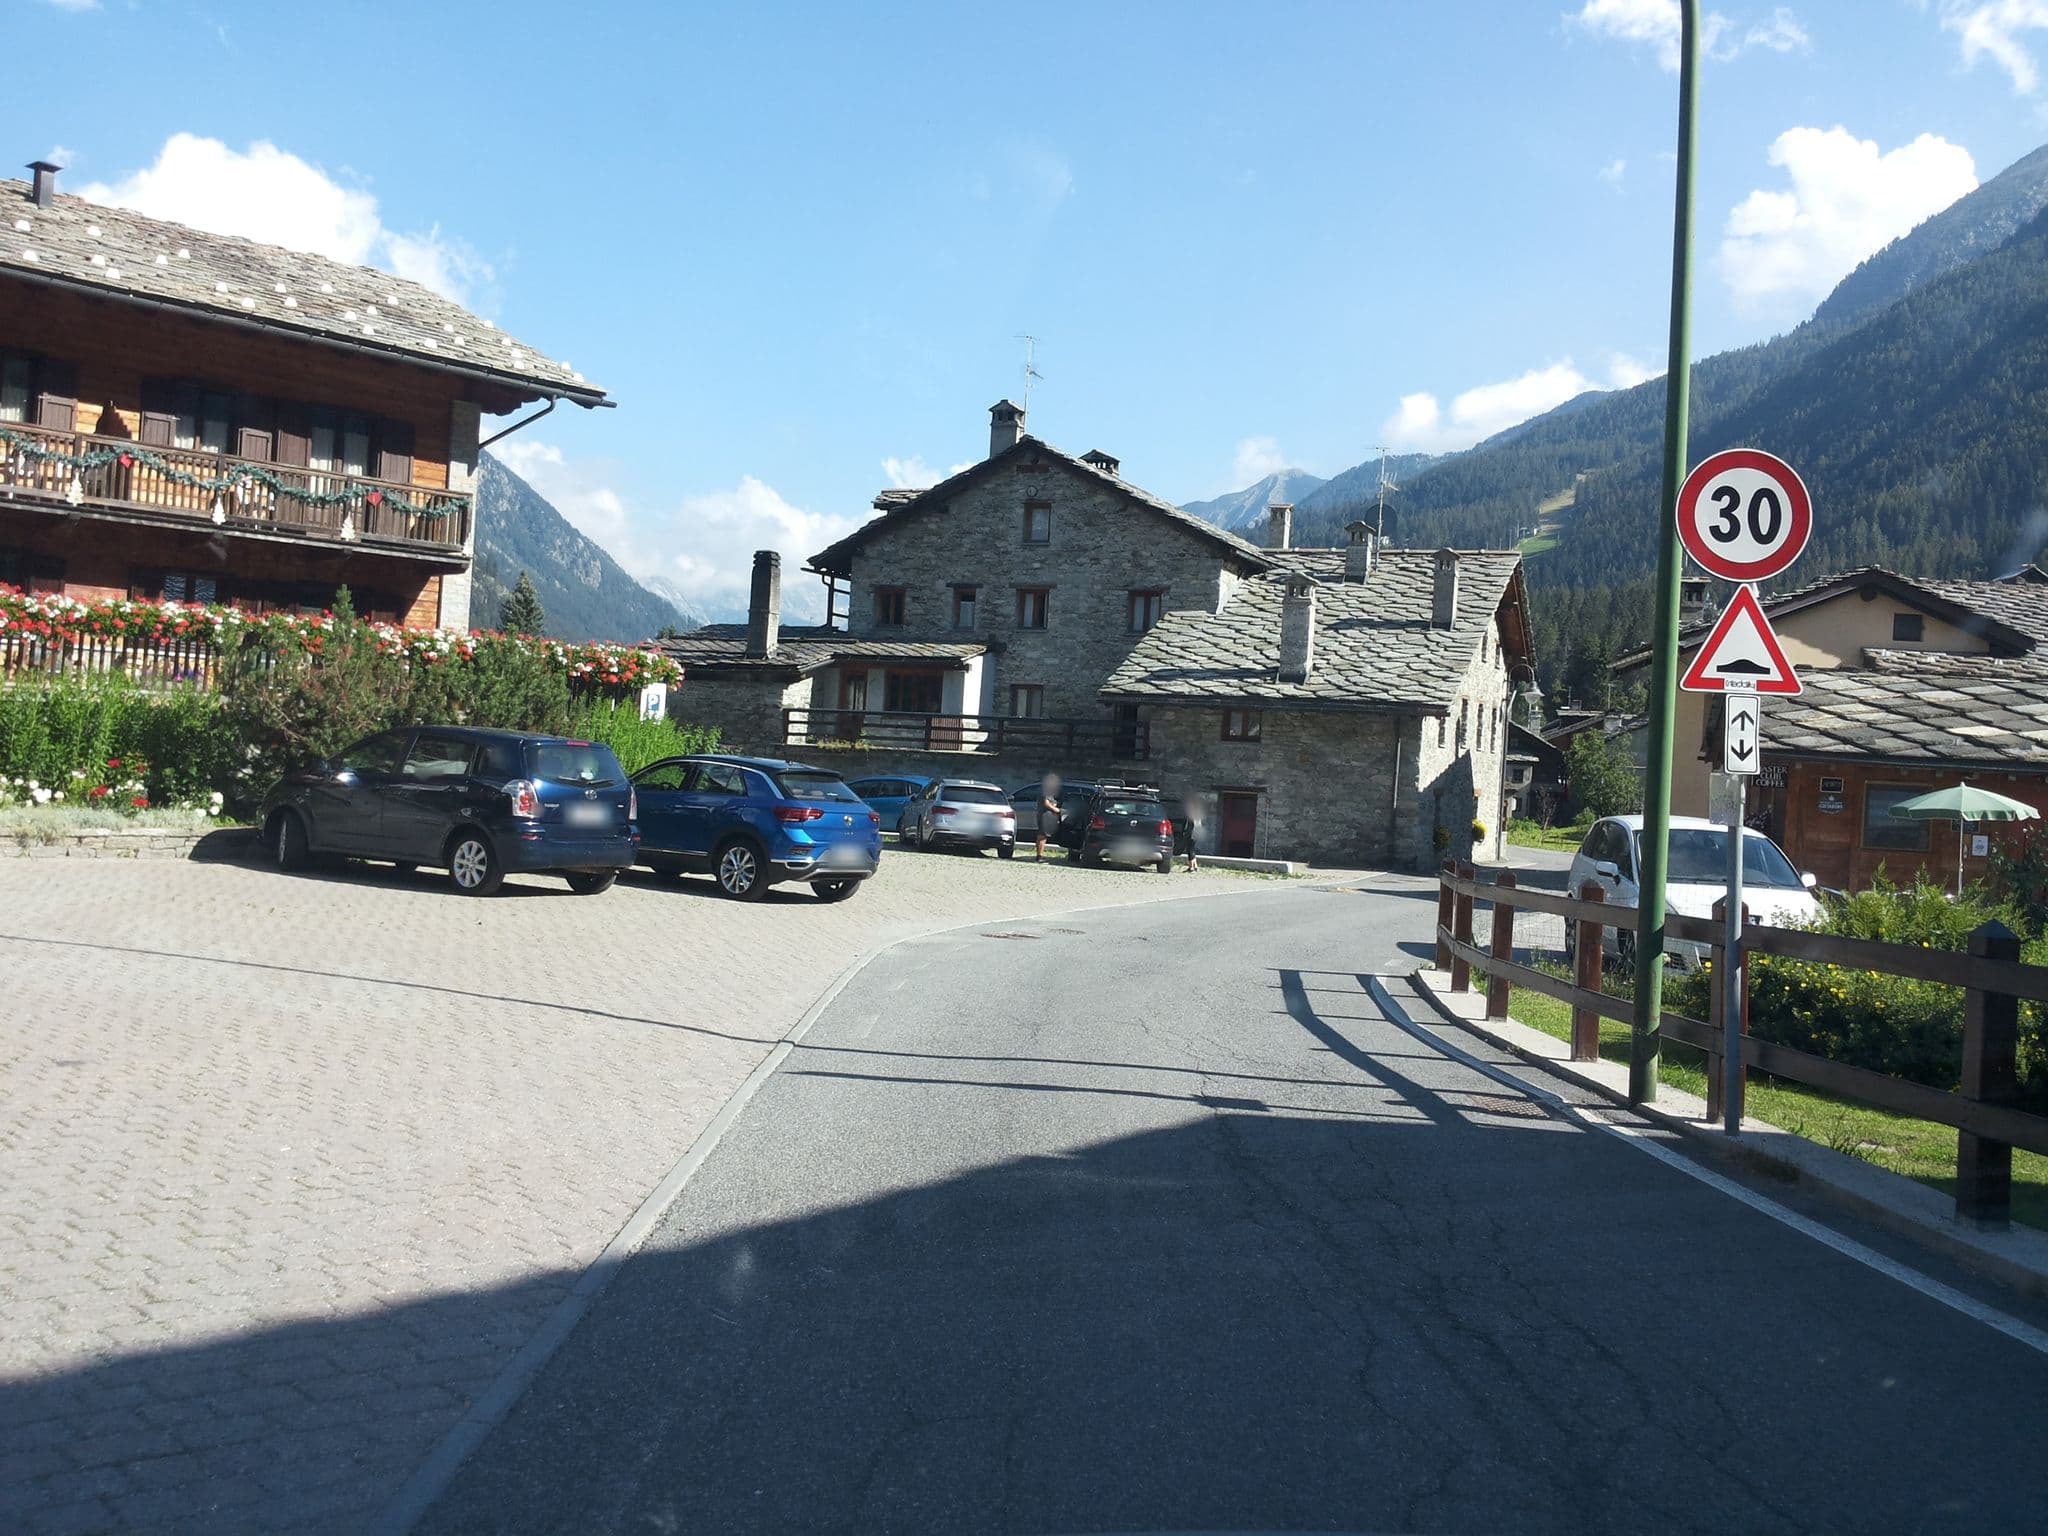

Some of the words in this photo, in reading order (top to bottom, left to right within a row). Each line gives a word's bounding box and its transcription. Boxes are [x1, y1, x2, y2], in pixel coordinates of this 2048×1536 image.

[1709, 486, 1782, 545] 30
[1759, 765, 1788, 774] ASTER
[1760, 772, 1782, 780] CLUB
[1755, 778, 1785, 788] COFFEE
